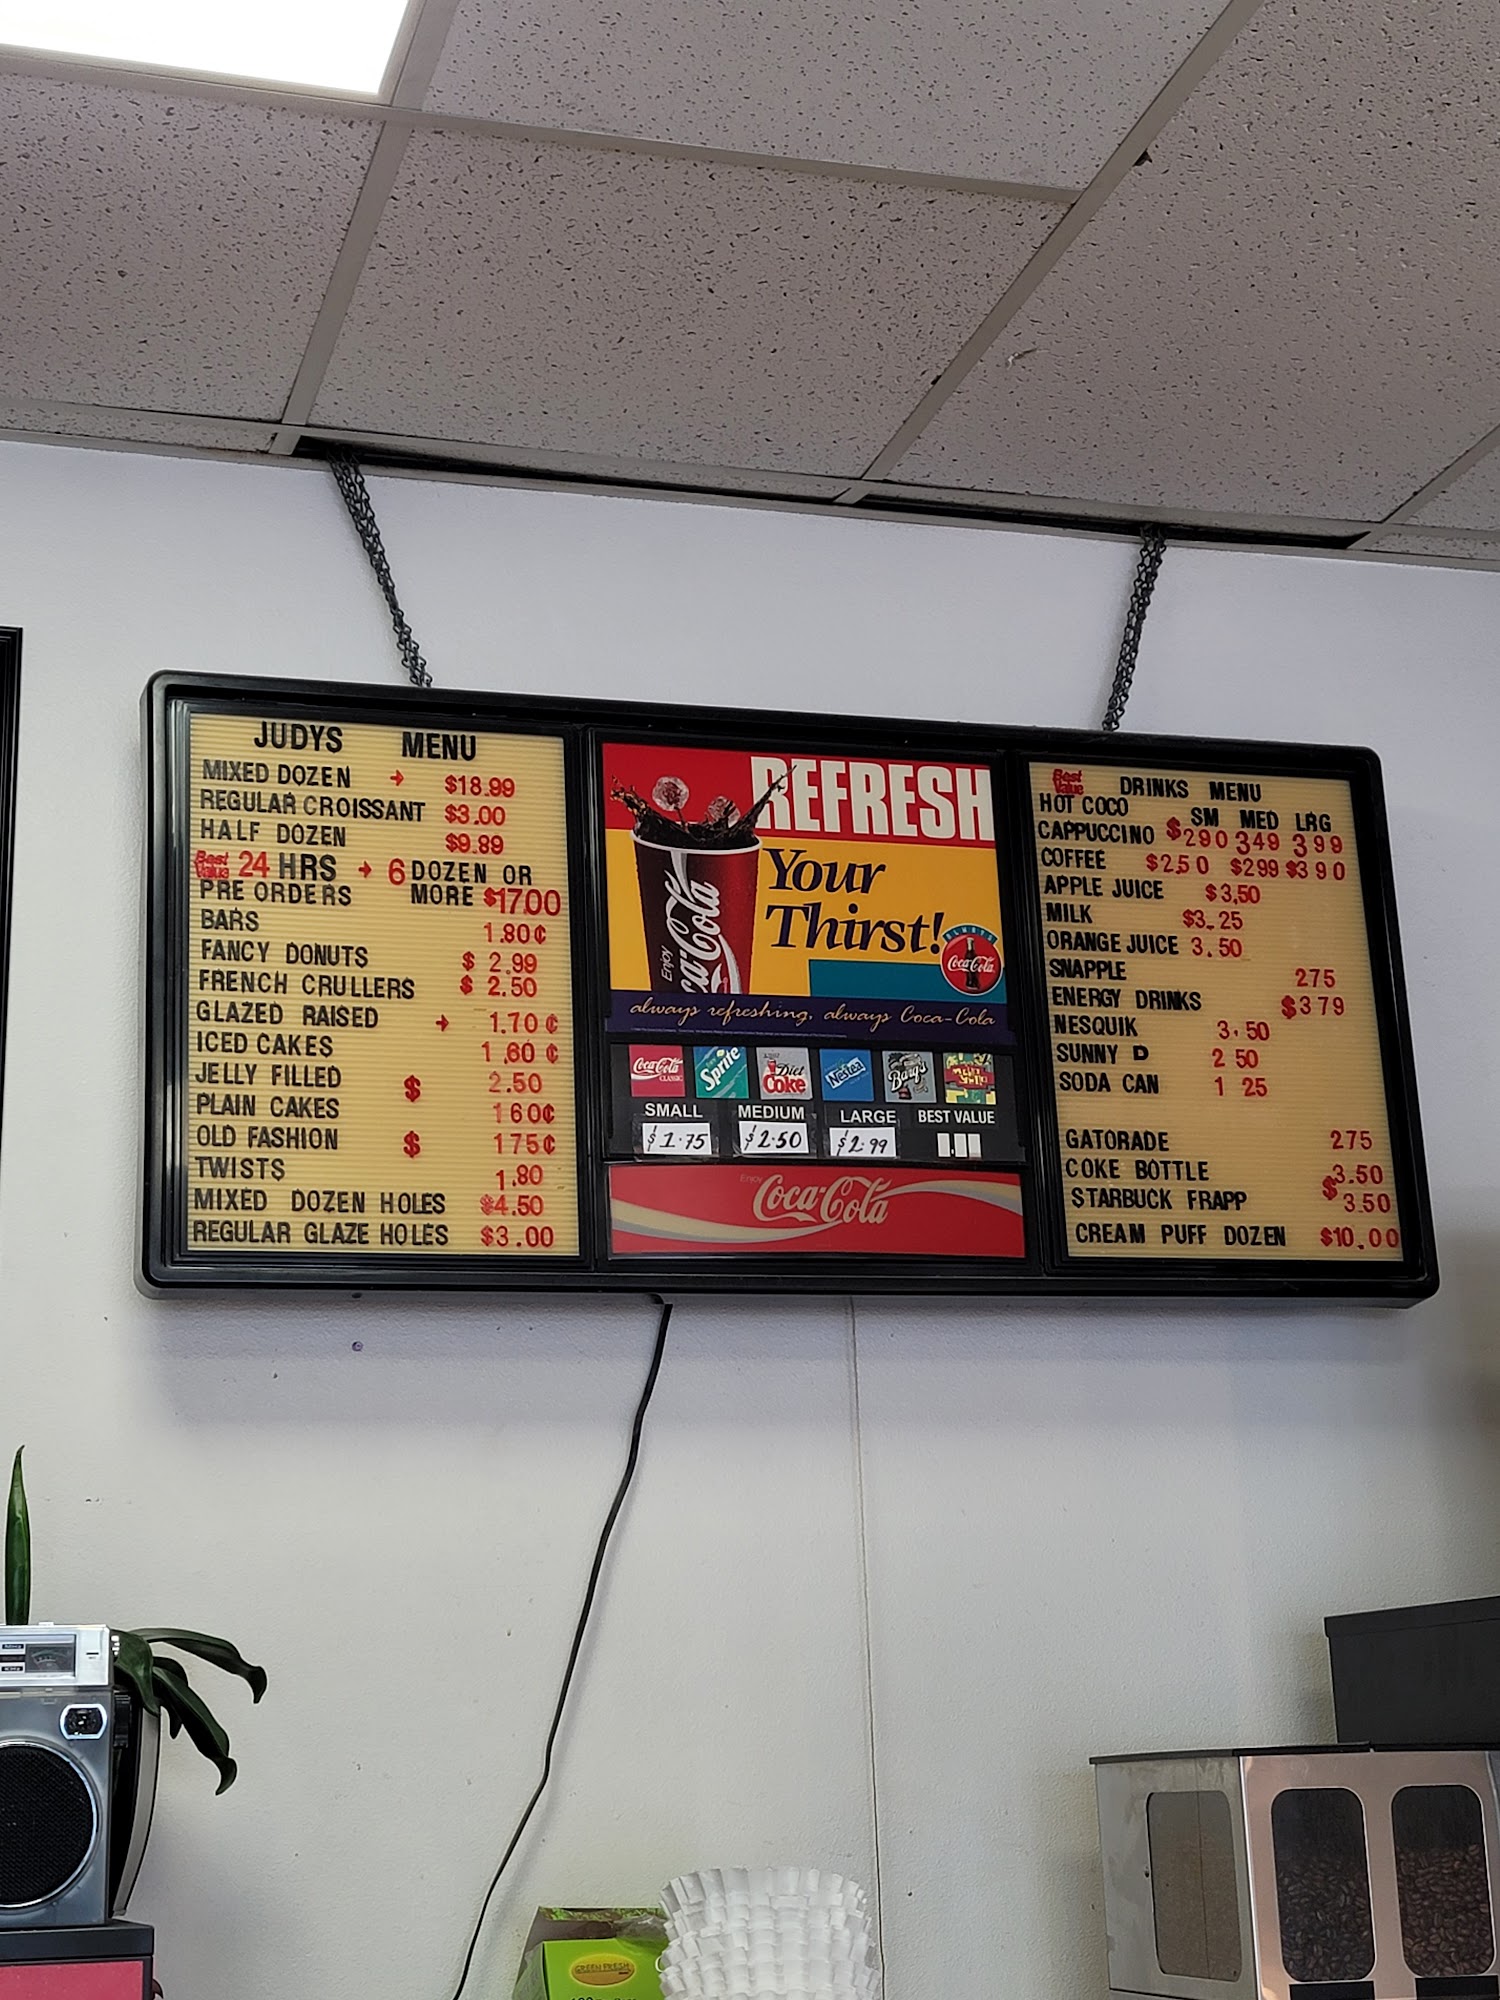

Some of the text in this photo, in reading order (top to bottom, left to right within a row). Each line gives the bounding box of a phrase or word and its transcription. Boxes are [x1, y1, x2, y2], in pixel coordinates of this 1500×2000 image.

[254, 721, 477, 761] JUDYS MENU
[203, 759, 515, 798] MIXED DOZEN $18.99
[1121, 777, 1261, 802] DRINKS MENU
[200, 789, 506, 826] REGULAR CROISSANT $3.00
[751, 756, 995, 841] REFRESH
[1039, 792, 1129, 816] HOT COCO
[1191, 807, 1331, 832] SM MED LRG
[200, 819, 504, 855] HALF DOZEN $9.89
[1038, 819, 1155, 844] CAPPUCCINO
[1235, 831, 1280, 855] 349
[238, 850, 532, 886] 24 HRS 6 DOZEN OR
[763, 848, 886, 894] Your
[1041, 847, 1107, 869] COFFEE
[1230, 858, 1279, 877] $299
[200, 880, 244, 901] PRE
[254, 881, 351, 906] ORDERS
[411, 884, 473, 906] MORE
[1044, 875, 1103, 897] APPLE
[1112, 879, 1164, 900] JUICE
[201, 908, 259, 932] BARS
[1046, 902, 1093, 923] MILK
[765, 902, 944, 955] Thirst!
[201, 938, 269, 964] FANCY
[286, 941, 369, 968] DONUTS
[1047, 930, 1121, 952] ORANGE
[1127, 934, 1179, 955] JUICE
[660, 945, 674, 982] Enjoy
[1050, 958, 1336, 987] SNAPPLE 275
[200, 970, 287, 994] FRENCH
[302, 973, 415, 1000] CRULLERS
[1052, 986, 1122, 1008] ENERGY
[1136, 989, 1202, 1011] DRINKS
[196, 1000, 284, 1025] GLAZED
[303, 1005, 379, 1028] RAISED
[630, 1002, 701, 1026] always
[707, 1001, 813, 1026] refreshing,
[824, 1007, 893, 1033] always
[900, 1007, 996, 1026] Coca-Cola
[1054, 1015, 1138, 1037] NESQUIK
[197, 1031, 248, 1053] ICED
[257, 1033, 333, 1058] CAKES
[1057, 1043, 1118, 1064] SUNNY
[1133, 1045, 1149, 1061] D
[195, 1063, 543, 1094] JELLY FILLED 2.50
[700, 1047, 741, 1091] Sprite
[776, 1063, 805, 1076] Diet
[830, 1060, 864, 1086] Nestea
[404, 1075, 421, 1102] $
[763, 1074, 806, 1094] Coke
[1059, 1072, 1111, 1092] SODA
[1122, 1074, 1159, 1093] CAN
[197, 1093, 255, 1117] PLAIN
[270, 1097, 339, 1119] CAKES
[645, 1103, 703, 1118] SMALL
[738, 1105, 805, 1120] MEDIUM
[840, 1110, 896, 1123] LARGE
[918, 1110, 995, 1124] BEST VALUE
[197, 1124, 236, 1147] OLD
[248, 1126, 338, 1150] FASHION
[403, 1130, 421, 1158] $
[1066, 1129, 1372, 1151] GATORADE 275
[196, 1156, 285, 1181] TWISTS
[1066, 1158, 1120, 1179] COKE
[1135, 1159, 1209, 1181] BOTTLE
[194, 1188, 545, 1217] MIXED DOZEN HOLES $4.50
[740, 1173, 892, 1224] Enjoy Coca-Cola
[1071, 1187, 1173, 1210] STARBUCK
[1188, 1190, 1247, 1211] FRAPP
[193, 1220, 555, 1248] REGULAR GLAZE HOLES $3.00
[1076, 1223, 1399, 1249] CREAM PUFF DOZEN $10.00
